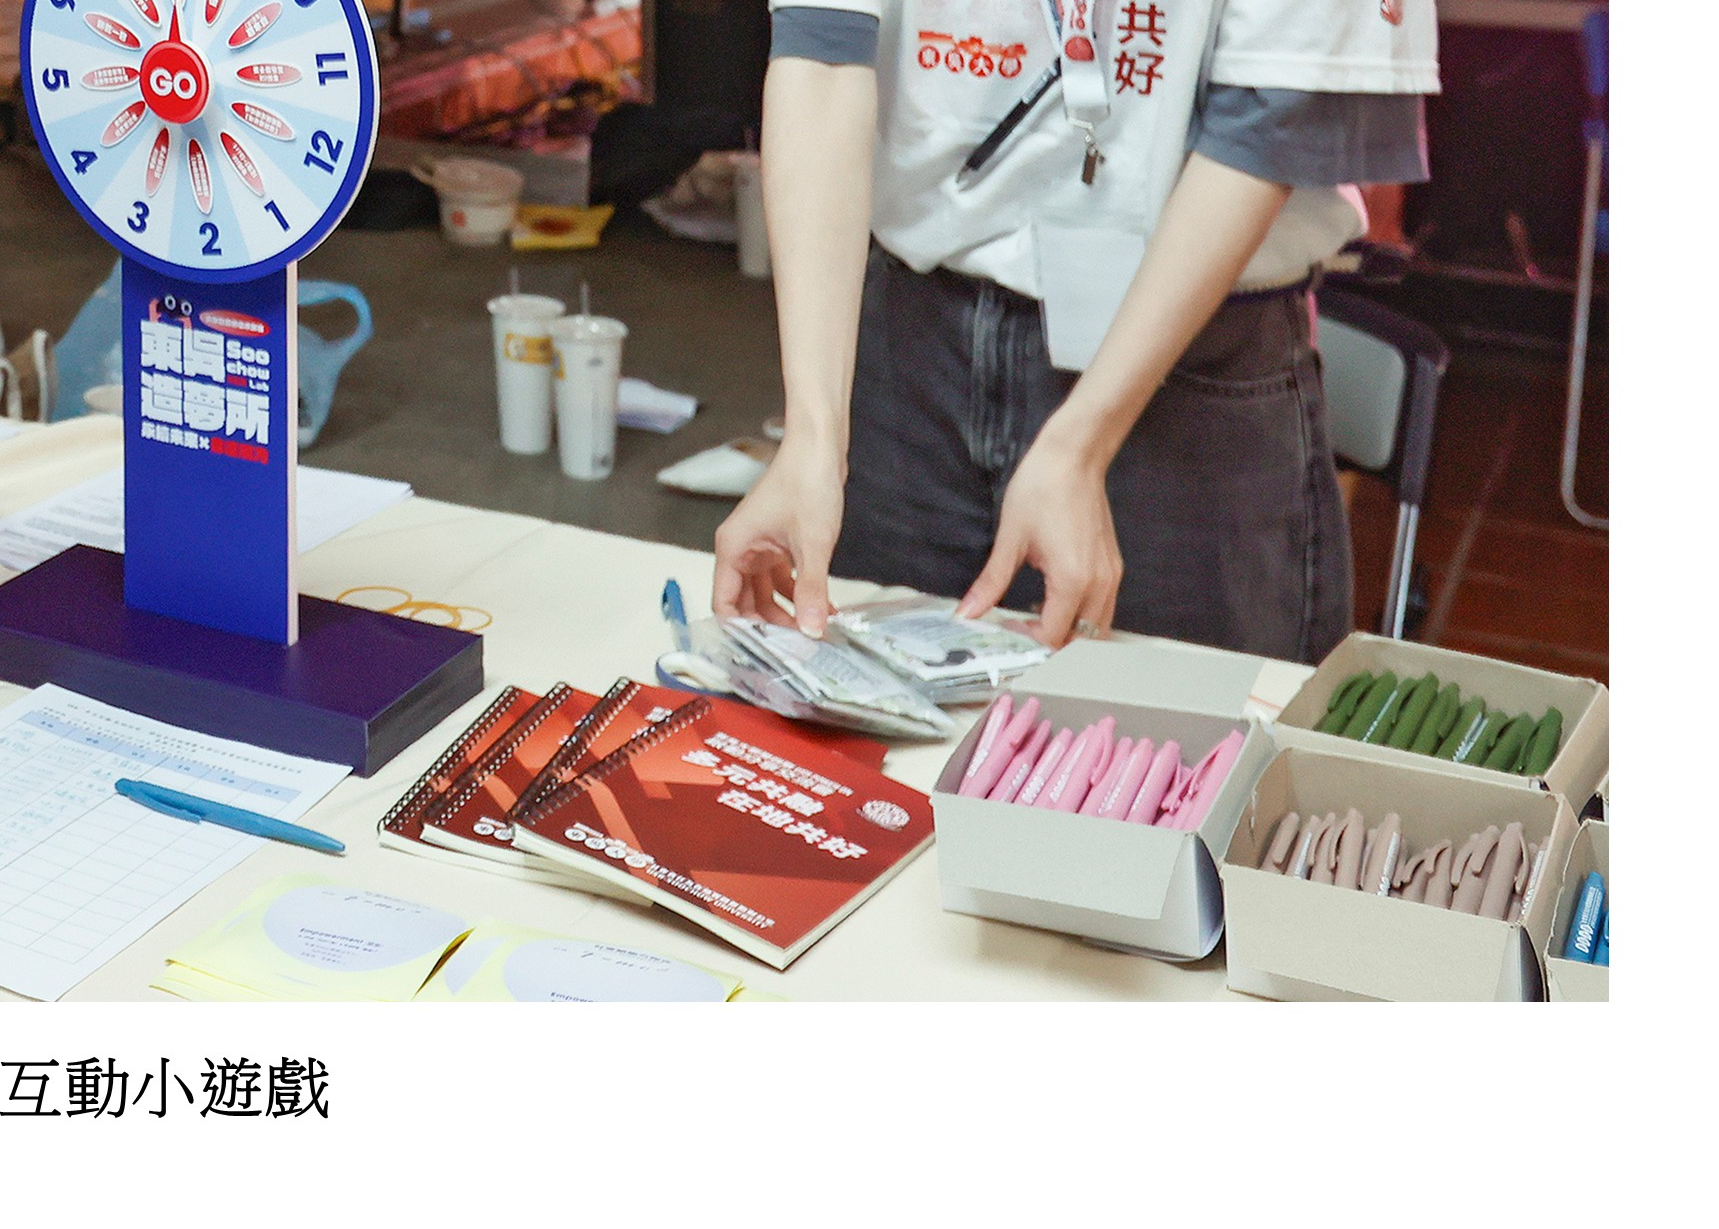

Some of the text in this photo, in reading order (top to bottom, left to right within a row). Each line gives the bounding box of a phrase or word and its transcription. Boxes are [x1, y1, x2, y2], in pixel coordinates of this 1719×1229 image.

[42, 68, 70, 92] 5
[149, 67, 197, 100] GO
[315, 52, 348, 86] 11
[71, 148, 98, 175] 4
[304, 130, 344, 175] 12
[127, 201, 150, 234] 3
[264, 200, 290, 231] 1
[199, 222, 222, 256] 2
[226, 339, 270, 366] Soo
[226, 360, 270, 381] chow
[681, 749, 825, 817] 多元共融
[717, 788, 869, 859] 在地共好
